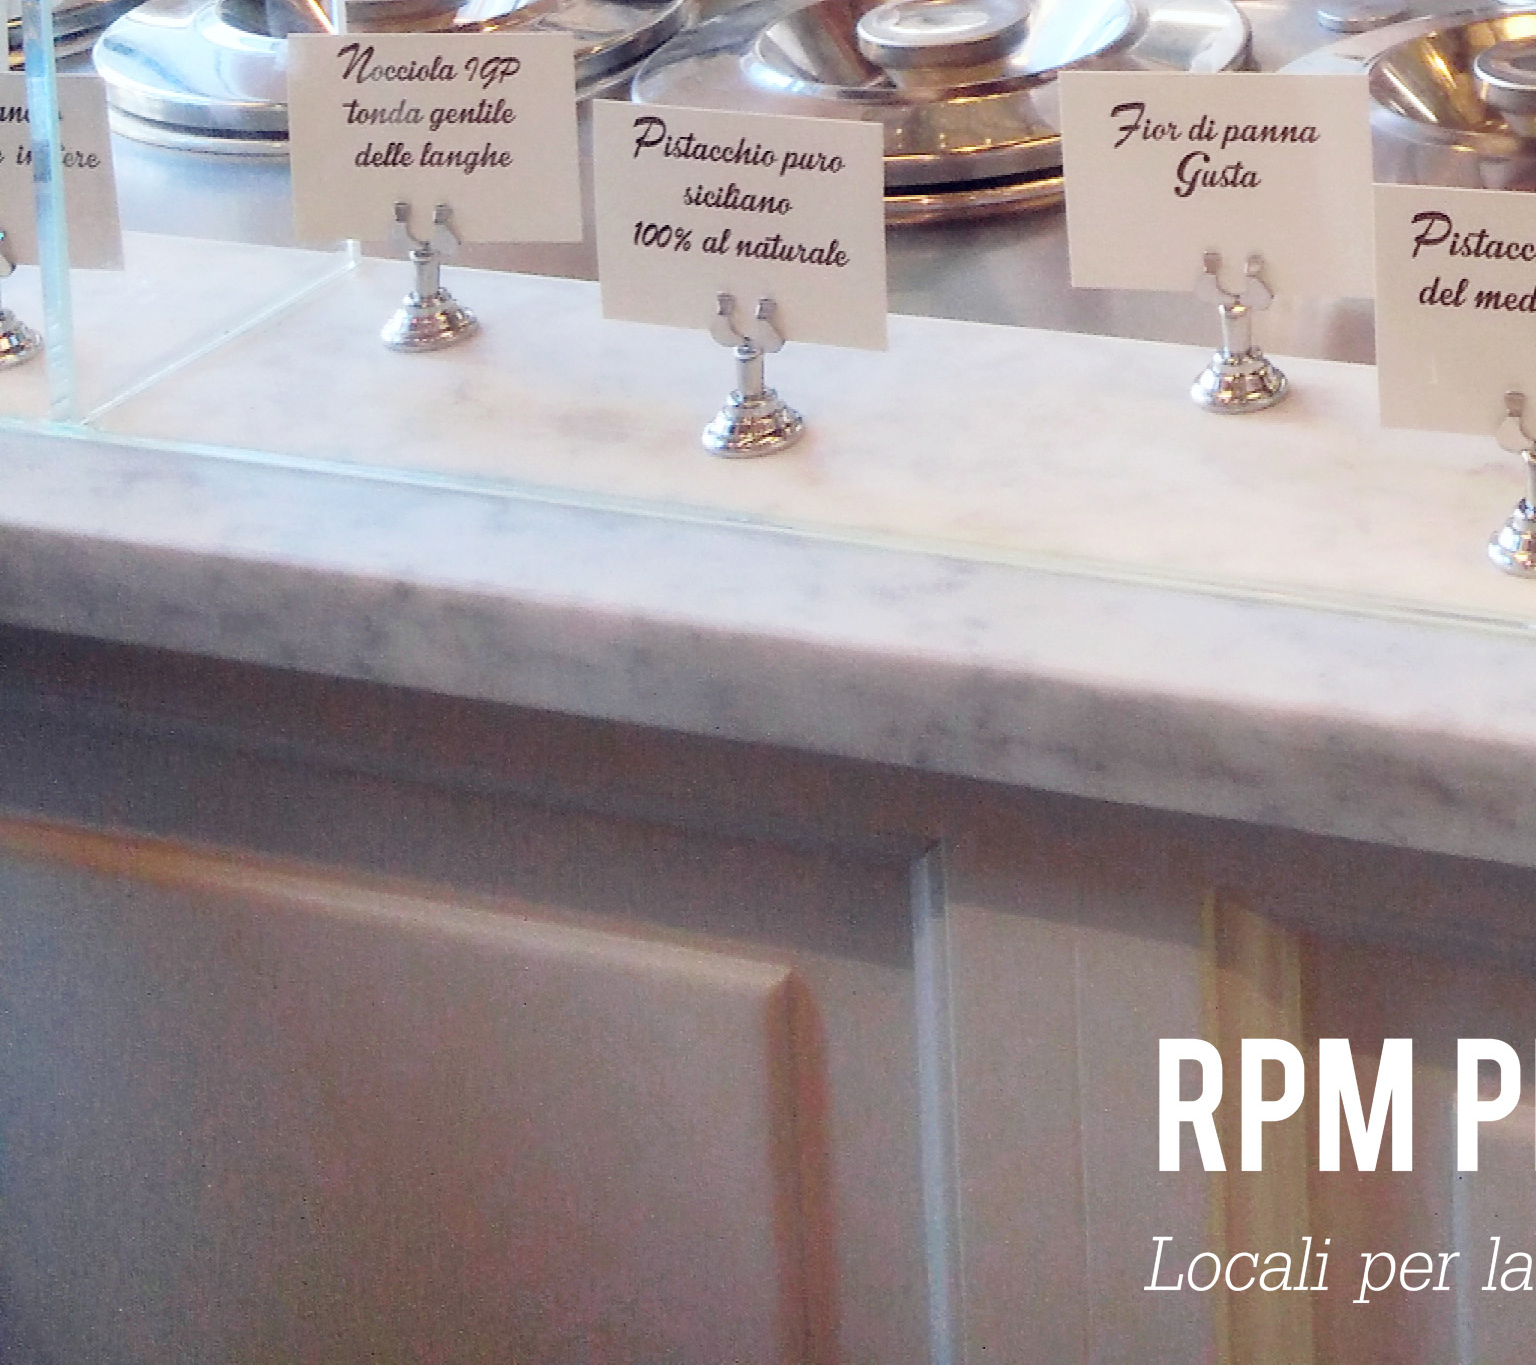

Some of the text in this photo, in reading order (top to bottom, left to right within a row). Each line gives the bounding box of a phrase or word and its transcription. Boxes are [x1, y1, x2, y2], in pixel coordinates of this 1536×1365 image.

[336, 42, 523, 89] Nocciola IGP
[341, 97, 518, 131] tonda gentile
[1110, 102, 1321, 150] Fior di panna
[355, 142, 514, 175] delle langhe
[632, 116, 846, 176] Pistacchio puro
[1174, 150, 1263, 198] Gusta
[683, 182, 793, 215] siciliano
[633, 221, 850, 269] 100% al naturale
[1418, 277, 1470, 308] del
